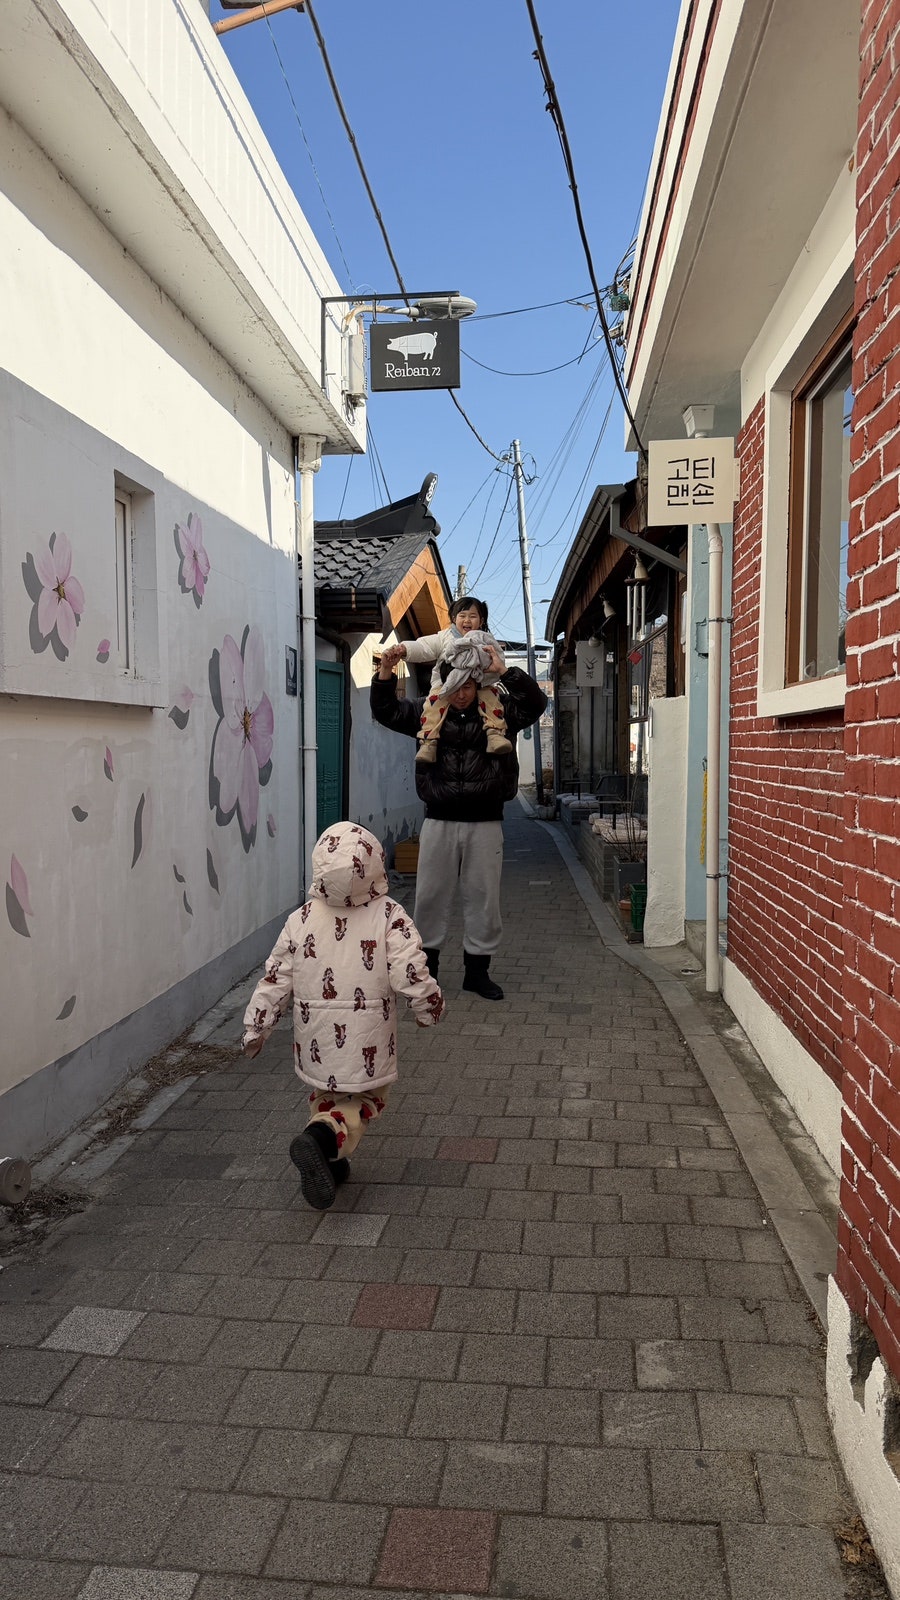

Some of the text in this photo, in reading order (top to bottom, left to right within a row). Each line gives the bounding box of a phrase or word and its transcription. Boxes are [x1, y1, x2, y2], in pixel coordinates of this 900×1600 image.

[384, 362, 441, 378] Reiban 72
[667, 456, 715, 481] 고티
[667, 483, 715, 507] 맨숀
